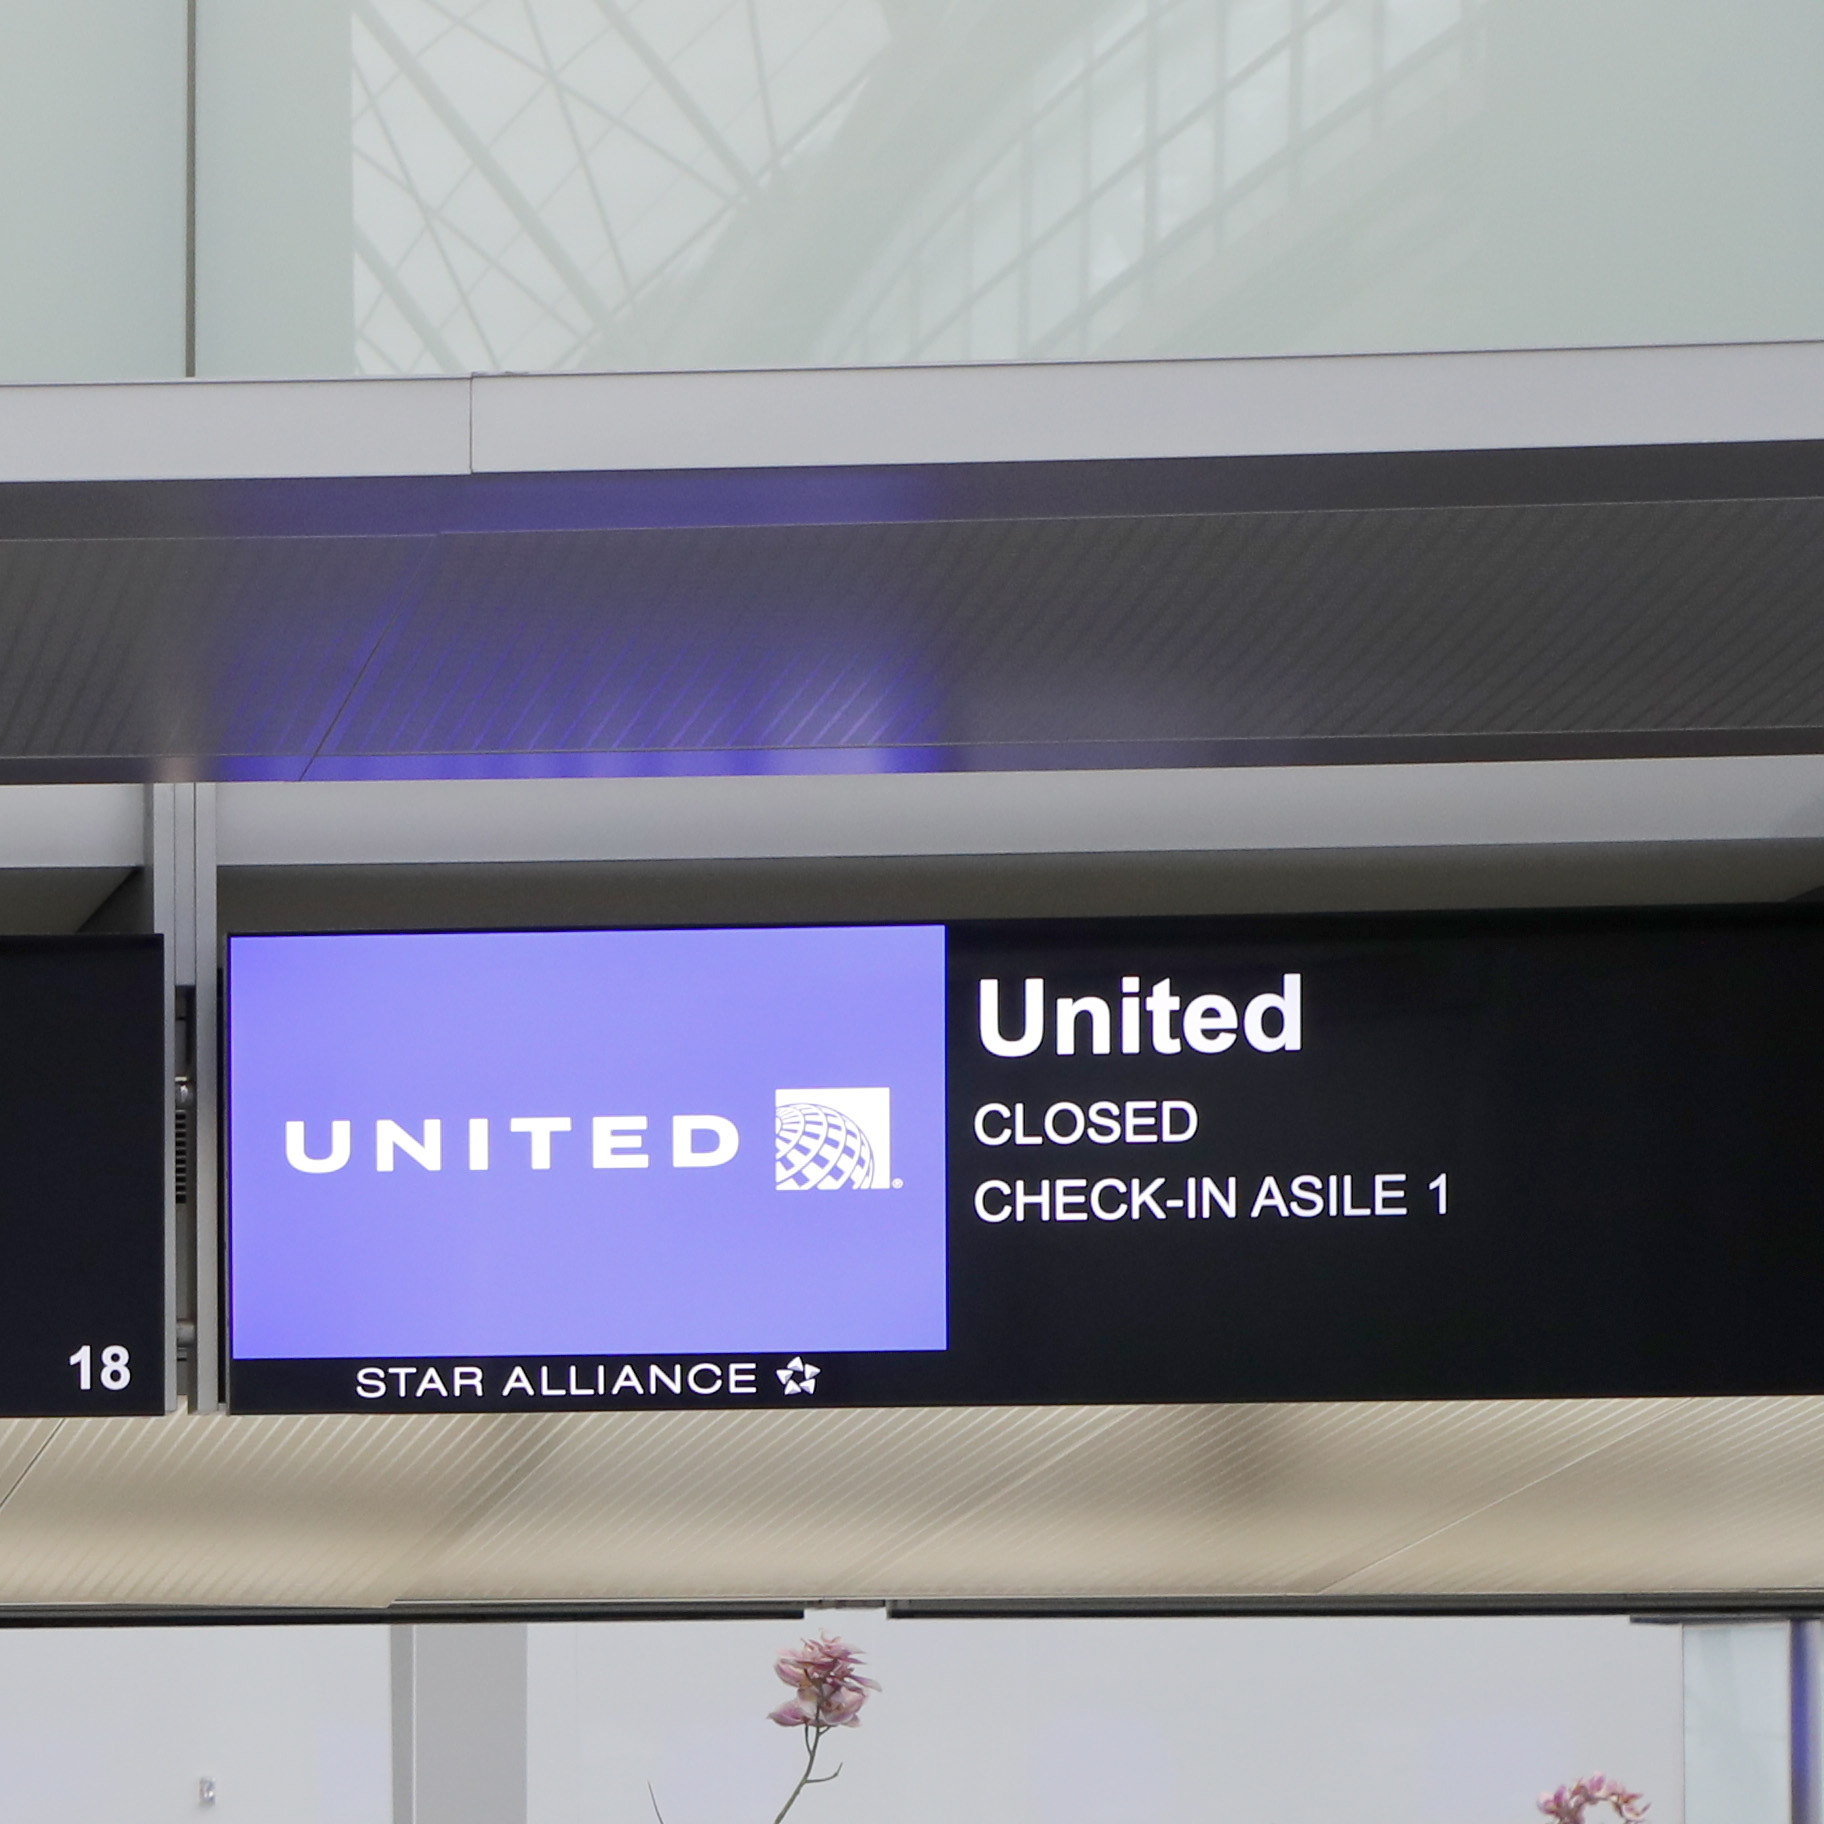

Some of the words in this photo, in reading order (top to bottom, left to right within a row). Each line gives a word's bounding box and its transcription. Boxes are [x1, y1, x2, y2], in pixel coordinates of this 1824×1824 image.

[979, 973, 1302, 1058] United
[285, 1114, 740, 1174] UNITED
[974, 1100, 1198, 1146] CLOSED
[974, 1176, 1238, 1223] CHECK-IN
[1250, 1173, 1408, 1219] ASILE
[1428, 1172, 1448, 1216] 1
[68, 1345, 131, 1391] 18
[356, 1366, 484, 1400] STAR
[502, 1361, 758, 1397] ALLIANCE
